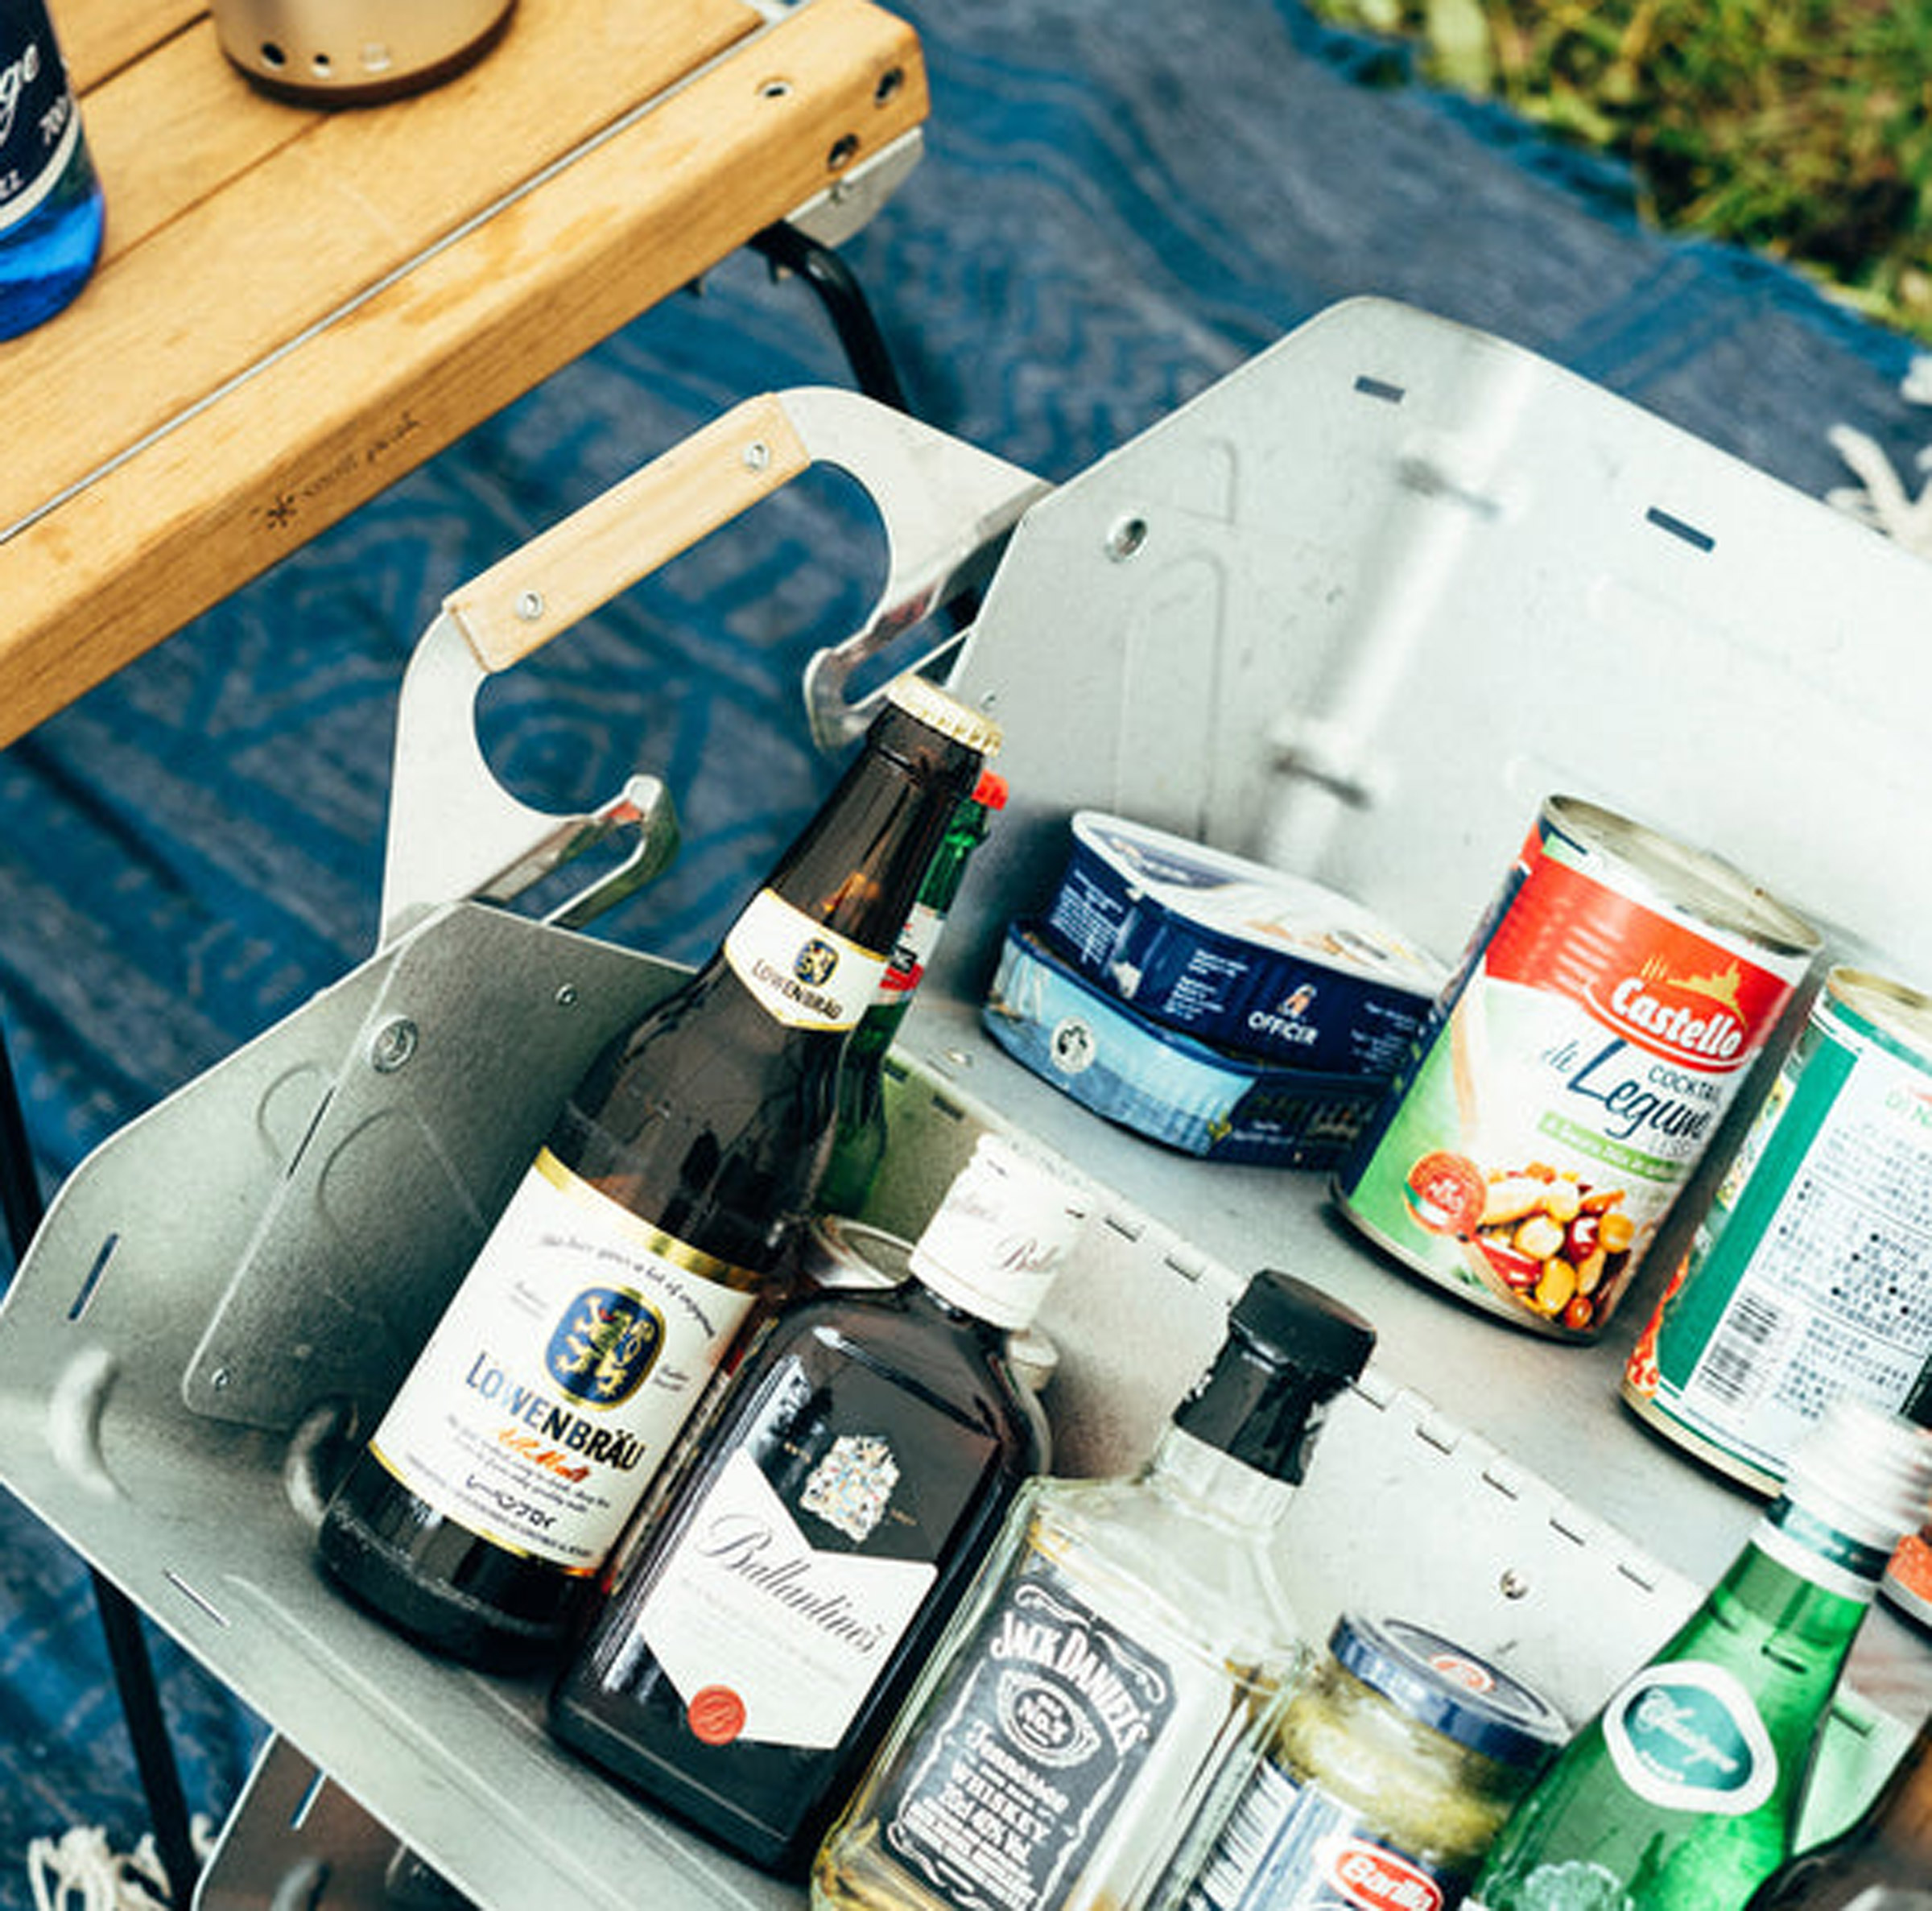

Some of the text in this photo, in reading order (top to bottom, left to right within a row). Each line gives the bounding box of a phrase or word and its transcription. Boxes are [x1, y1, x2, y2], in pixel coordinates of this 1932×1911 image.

[1247, 1009, 1319, 1046] OFFICER
[1611, 977, 1744, 1058] Castello
[989, 1610, 1153, 1756] JACK DANIEL'S
[1340, 1853, 1436, 1909] Barilla
